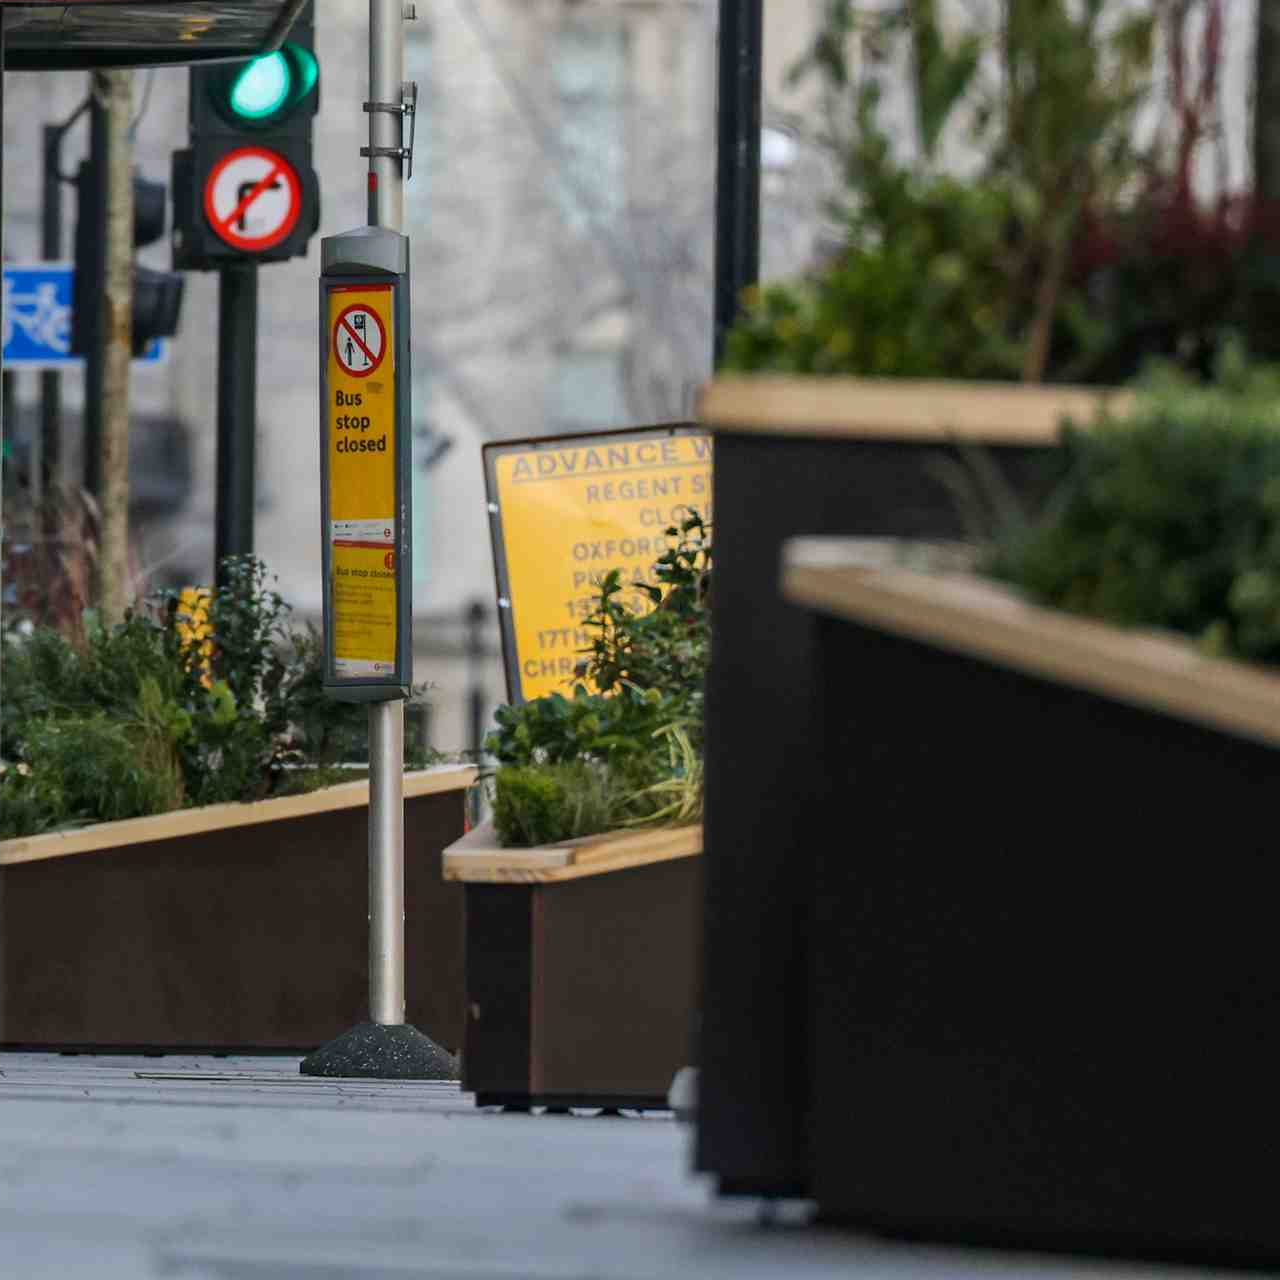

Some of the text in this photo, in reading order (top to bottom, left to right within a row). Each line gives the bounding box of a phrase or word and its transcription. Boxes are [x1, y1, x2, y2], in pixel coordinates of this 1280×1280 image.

[336, 390, 362, 406] Bus
[336, 415, 370, 431] stop
[336, 434, 386, 453] closed
[513, 443, 678, 476] ADVANCE
[587, 477, 680, 503] REGENT
